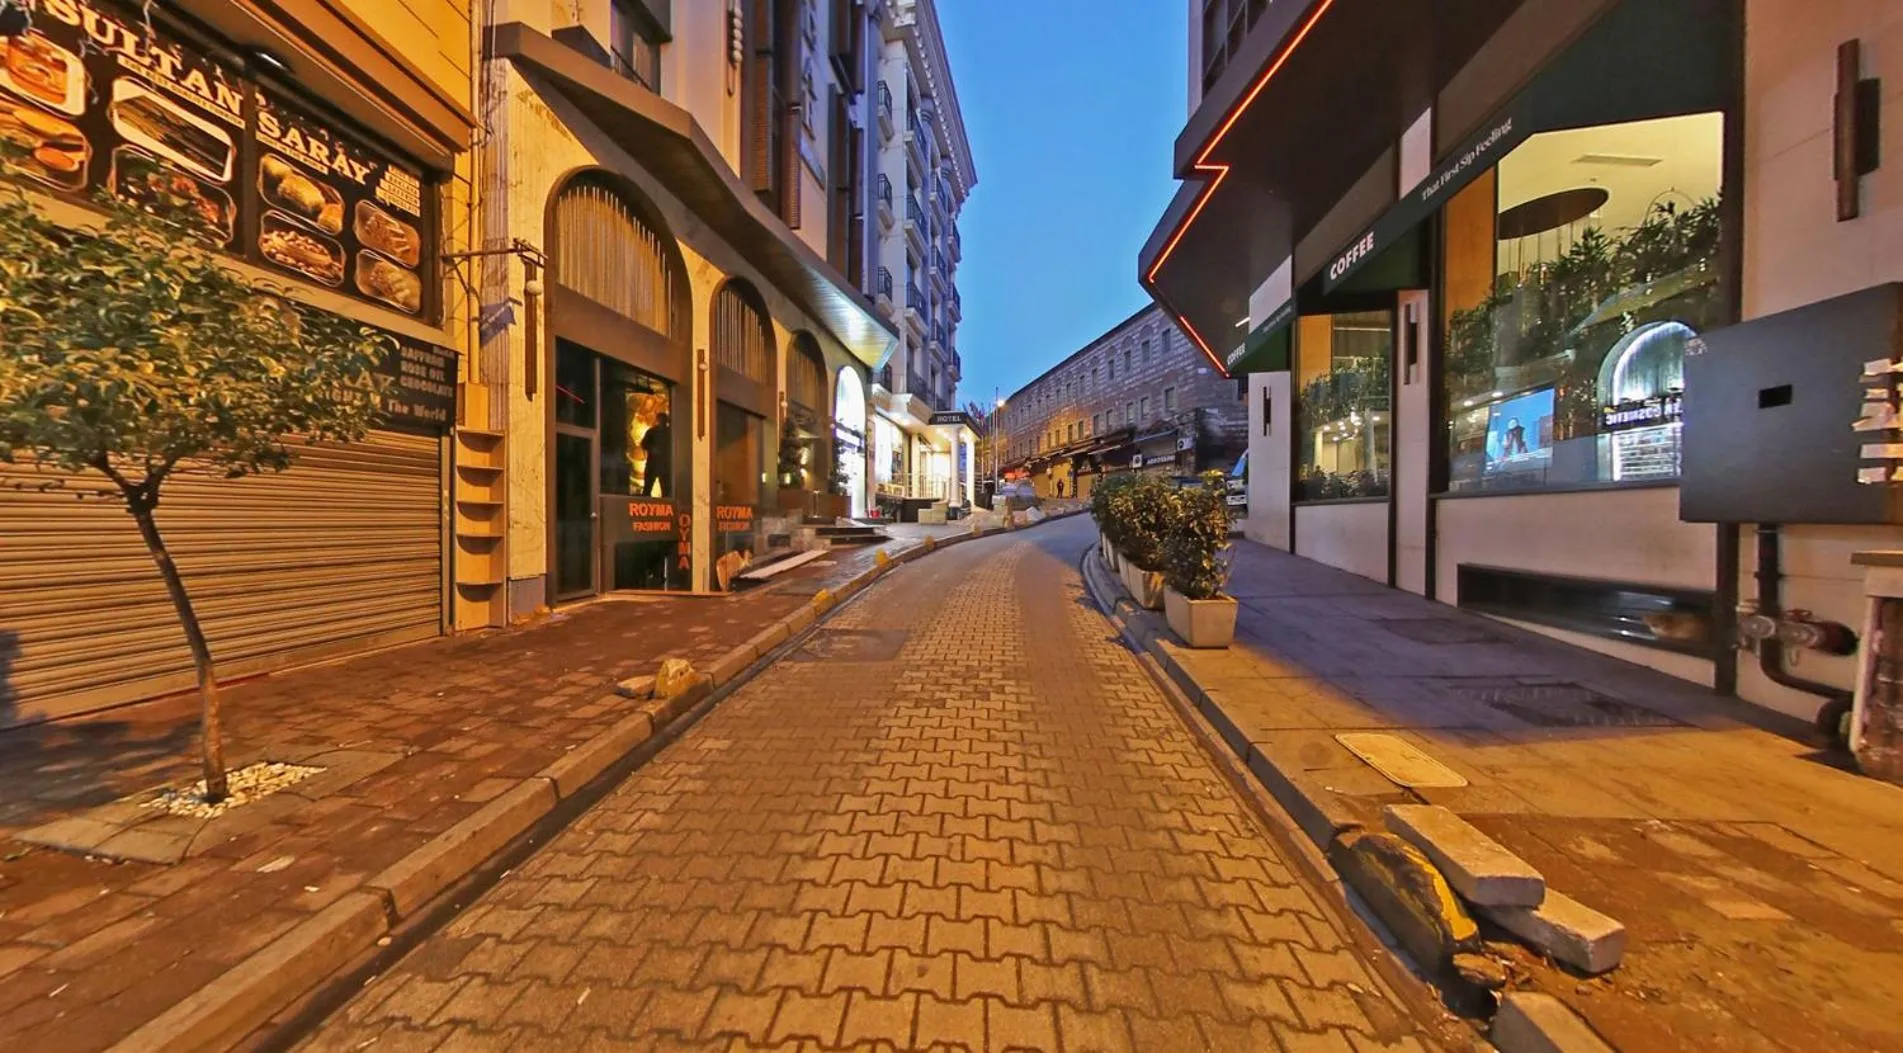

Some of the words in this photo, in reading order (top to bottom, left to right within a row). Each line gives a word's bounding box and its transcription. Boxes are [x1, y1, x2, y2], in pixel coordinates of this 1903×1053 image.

[43, 0, 244, 115] SULTAN
[257, 110, 371, 185] SARAY
[1422, 180, 1440, 201] That
[1329, 232, 1375, 281] COFFEE
[1227, 342, 1246, 365] COFFEE
[628, 503, 674, 516] ROYMA
[716, 506, 753, 519] ROYMA
[632, 521, 671, 531] FASHION
